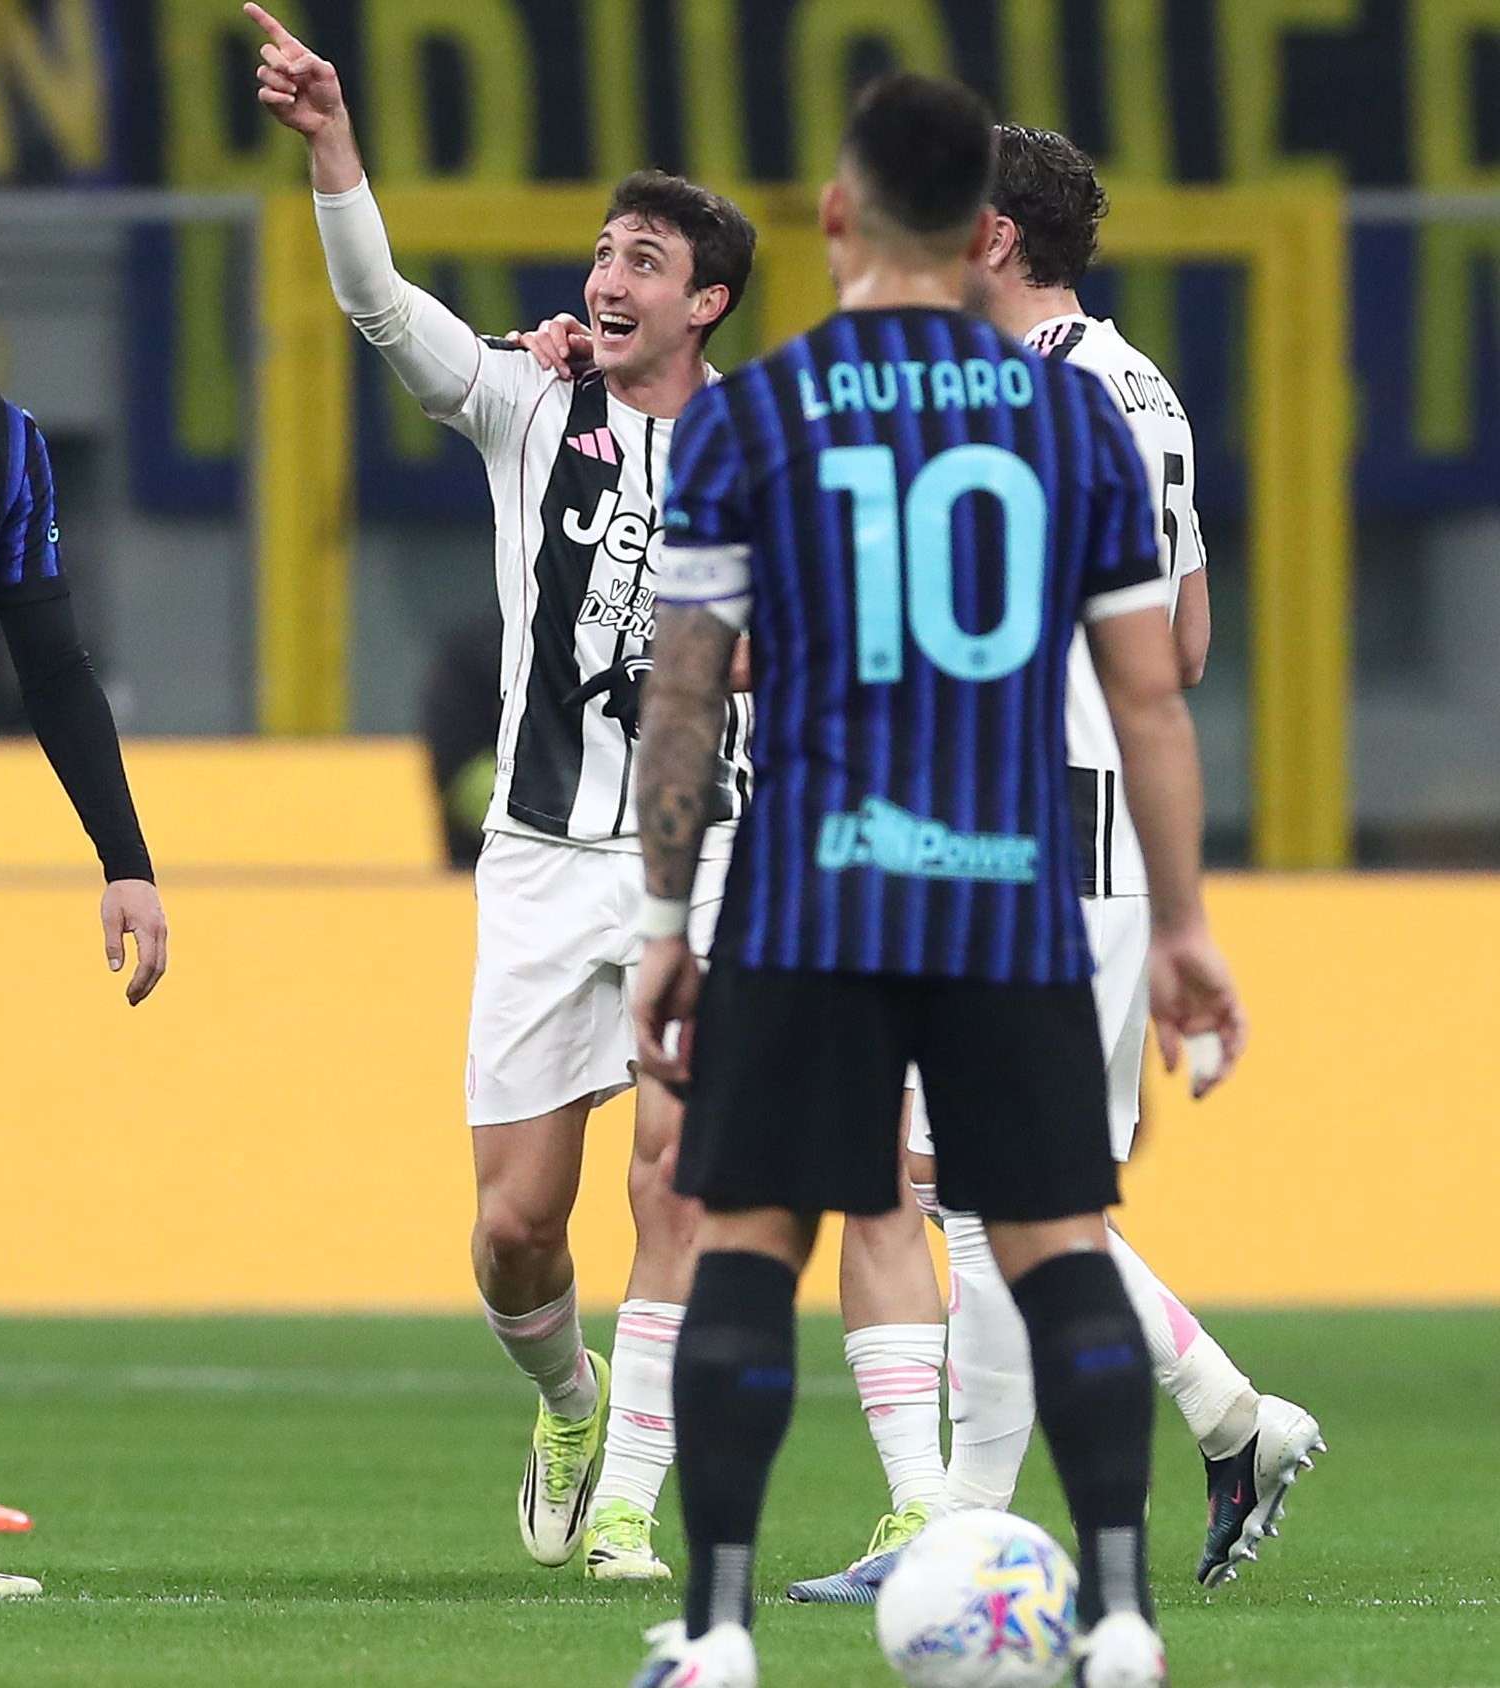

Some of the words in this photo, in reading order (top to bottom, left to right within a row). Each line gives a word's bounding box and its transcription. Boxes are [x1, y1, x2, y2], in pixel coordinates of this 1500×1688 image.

[799, 357, 1034, 421] LAUTARO
[562, 488, 666, 576] Je
[818, 443, 1047, 684] 10
[578, 590, 657, 641] Detro
[610, 579, 656, 612] VISI
